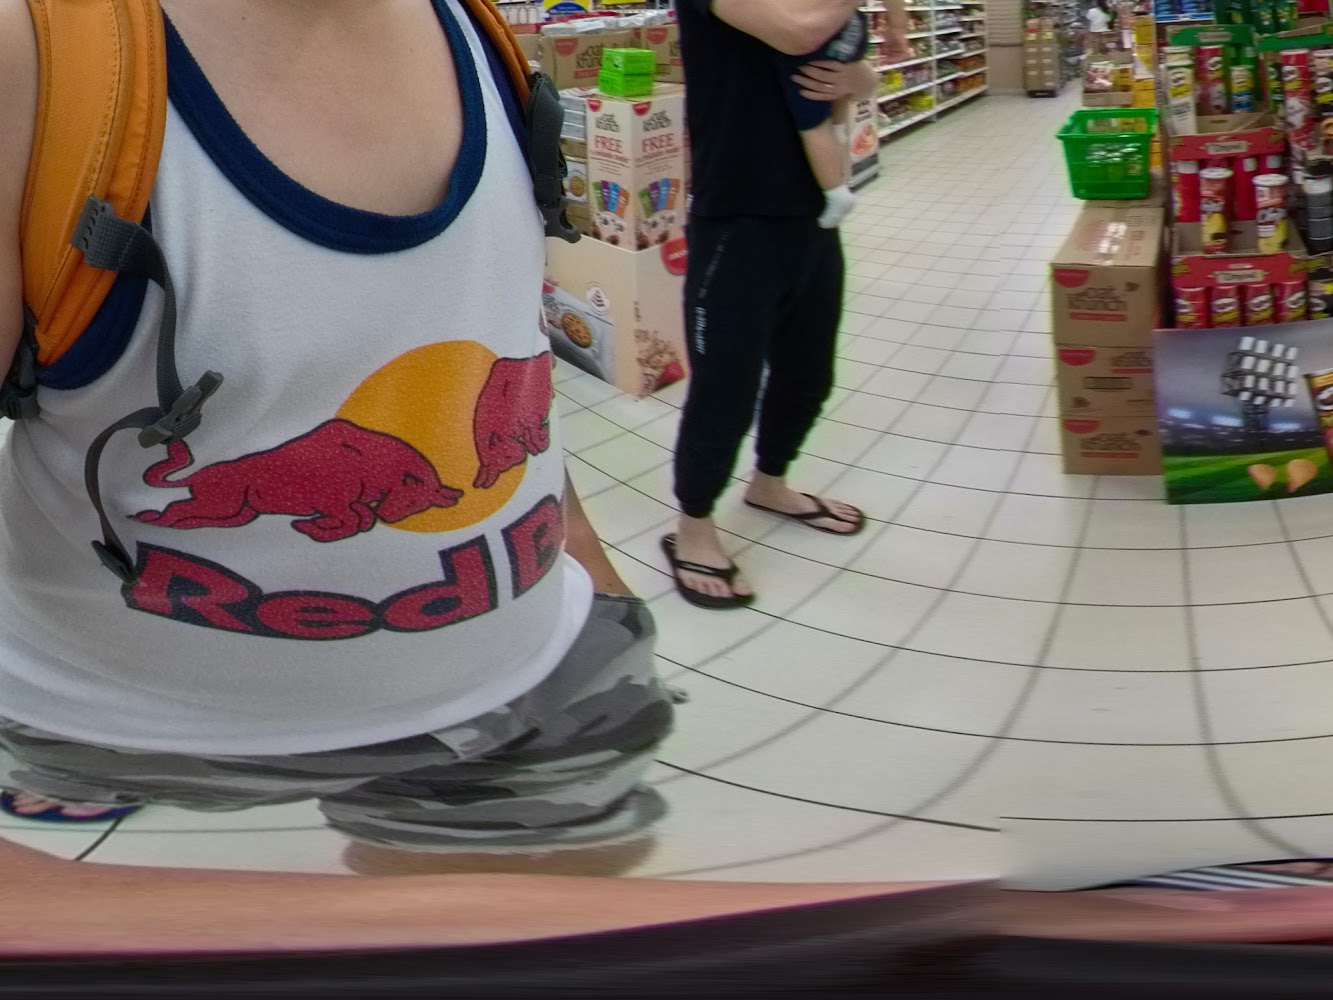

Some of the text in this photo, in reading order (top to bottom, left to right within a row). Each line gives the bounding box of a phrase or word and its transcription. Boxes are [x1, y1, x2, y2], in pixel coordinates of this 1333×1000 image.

[594, 135, 622, 153] FREE
[642, 133, 675, 152] FREE
[122, 535, 498, 640] Red
